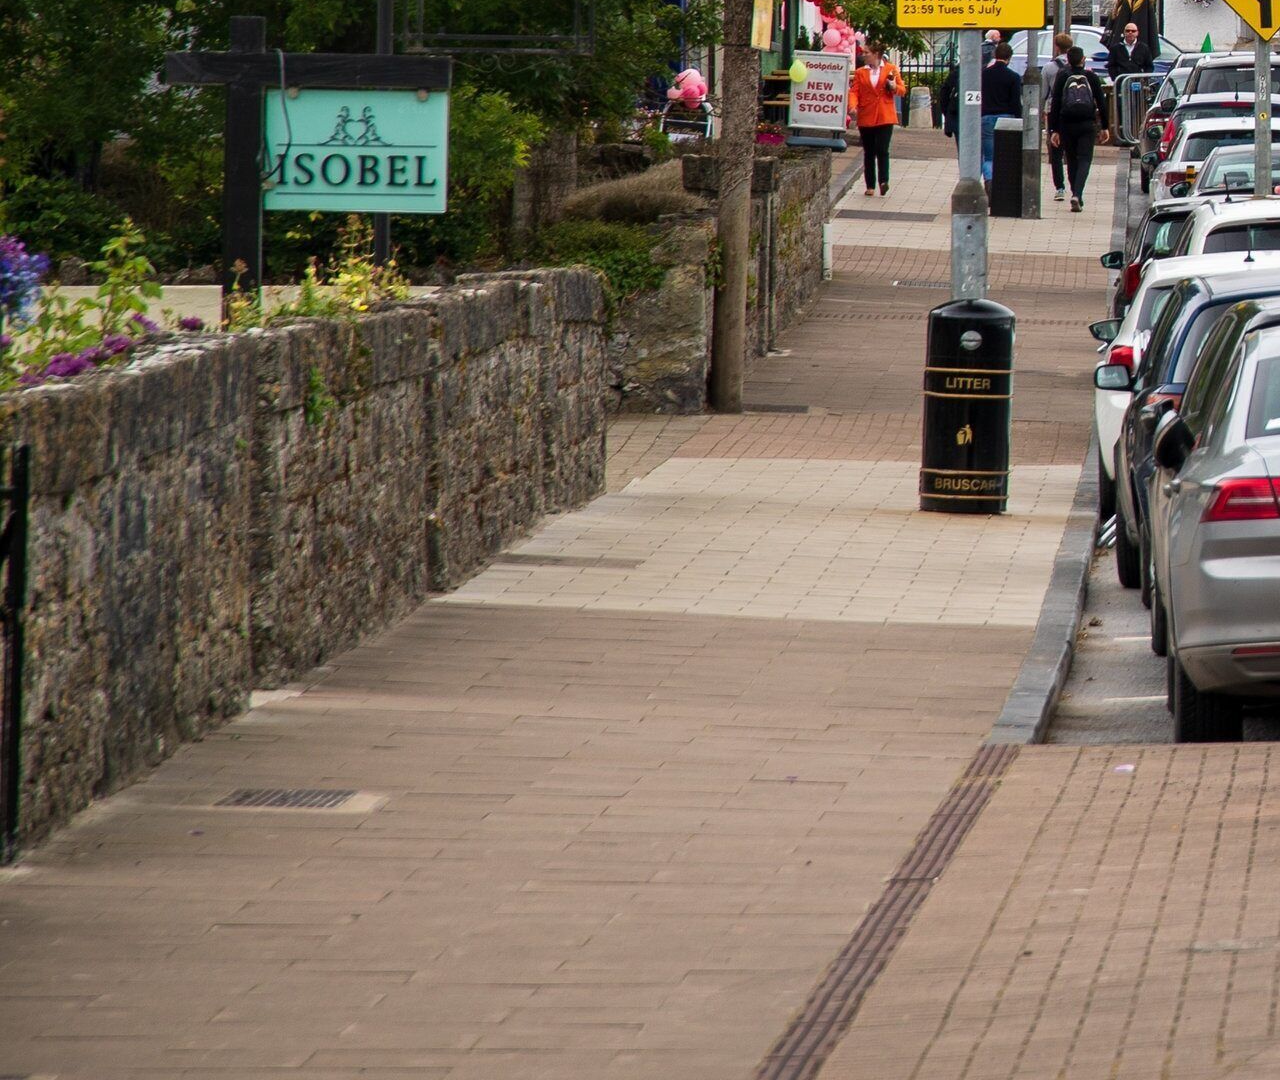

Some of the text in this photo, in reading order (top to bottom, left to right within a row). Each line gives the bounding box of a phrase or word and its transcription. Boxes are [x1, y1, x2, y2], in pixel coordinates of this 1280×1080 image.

[904, 4, 1002, 16] 23:59 Tues 5 July
[805, 61, 844, 71] Footprints
[807, 81, 833, 91] NEW
[796, 92, 843, 103] SEASON
[799, 103, 838, 114] STOCK
[277, 152, 437, 186] ISOBEL
[945, 377, 991, 390] LITTER
[934, 477, 998, 491] BRUSCAR
